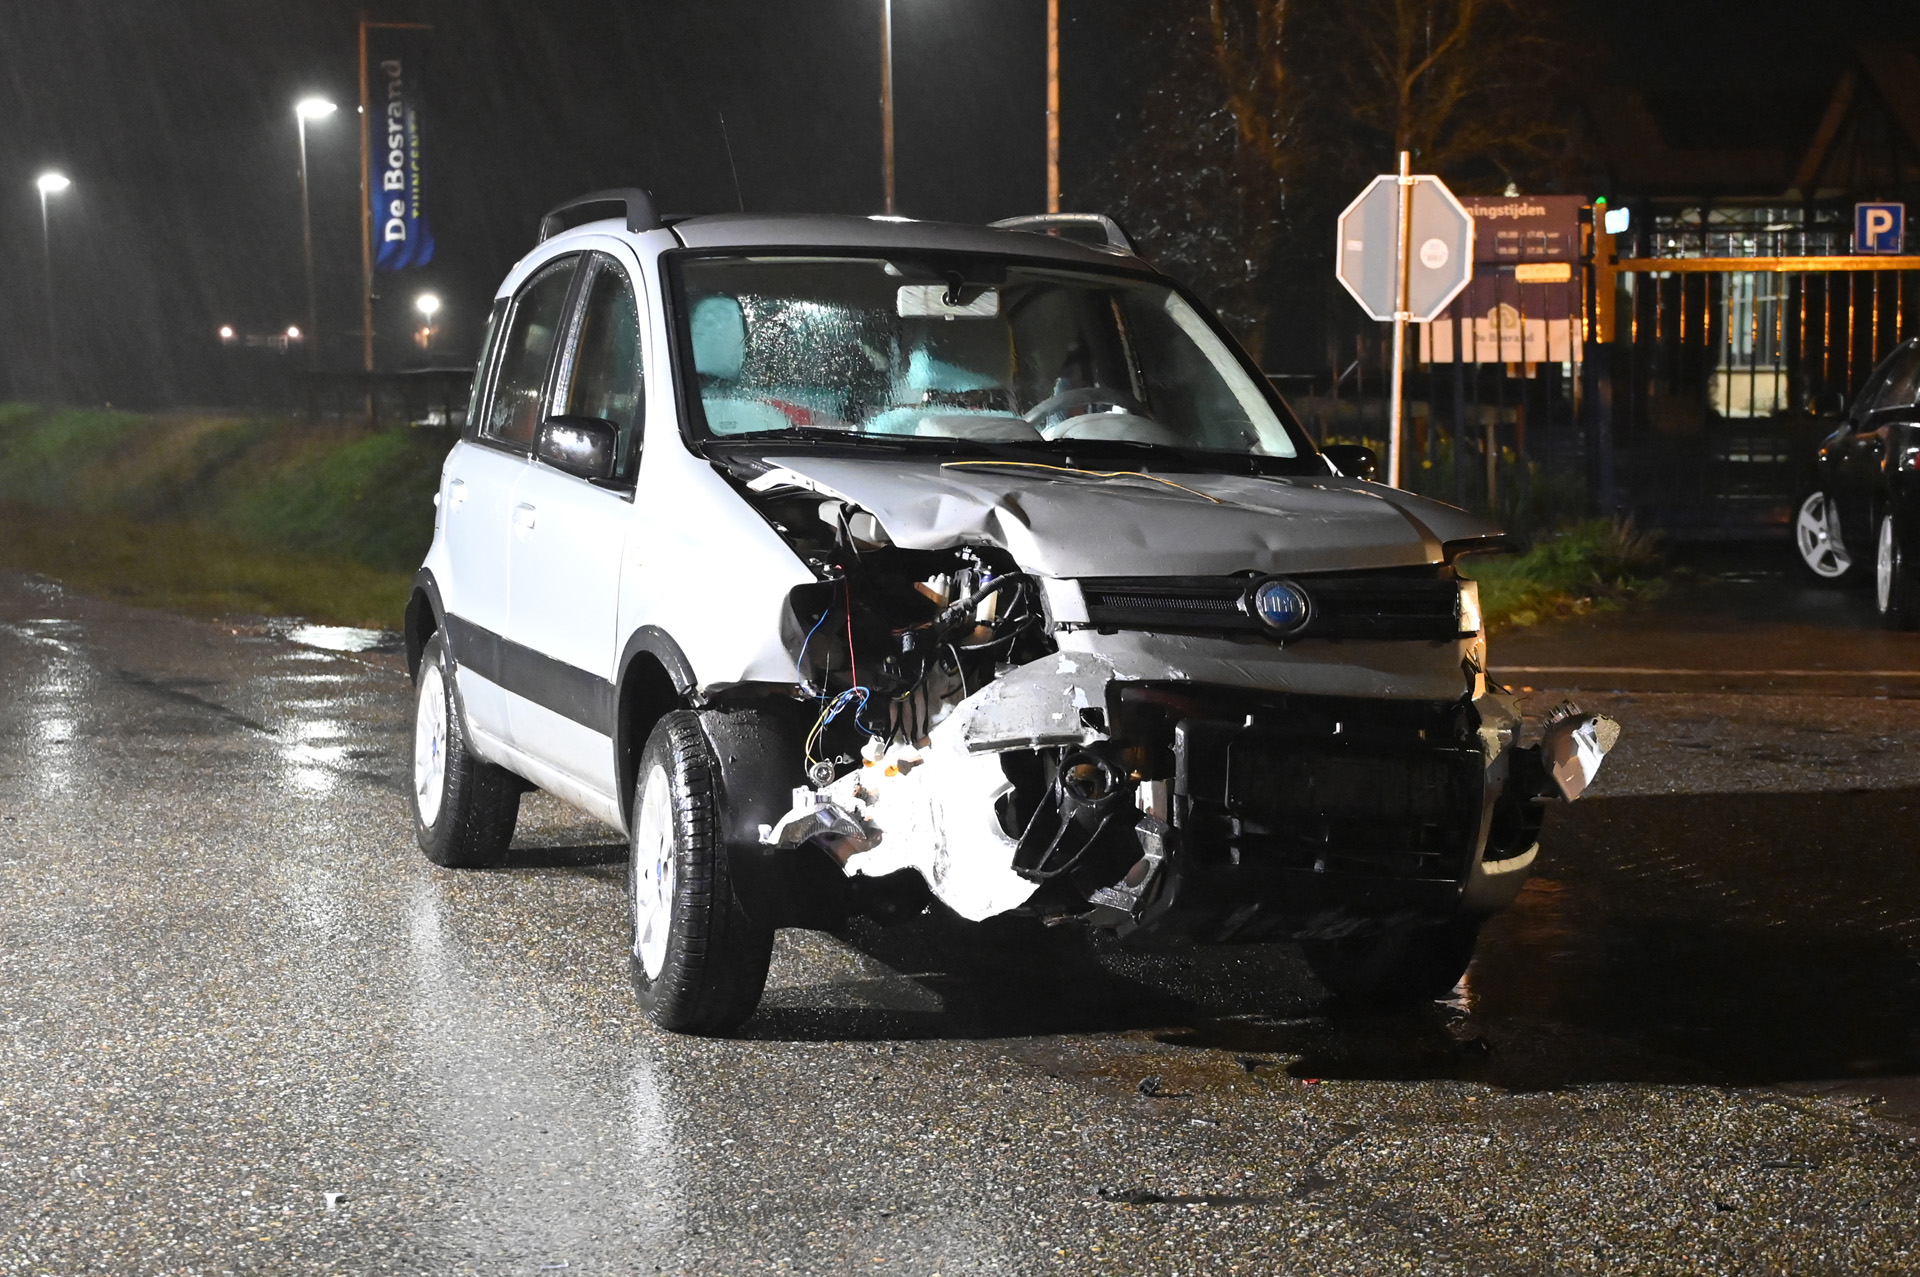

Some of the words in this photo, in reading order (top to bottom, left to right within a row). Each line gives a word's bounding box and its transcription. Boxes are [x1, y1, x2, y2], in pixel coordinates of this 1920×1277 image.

[381, 60, 405, 192] Bosrand
[410, 112, 421, 220] TUINCENT
[384, 198, 406, 242] De
[1465, 202, 1546, 220] ningstijden
[1866, 209, 1893, 247] P
